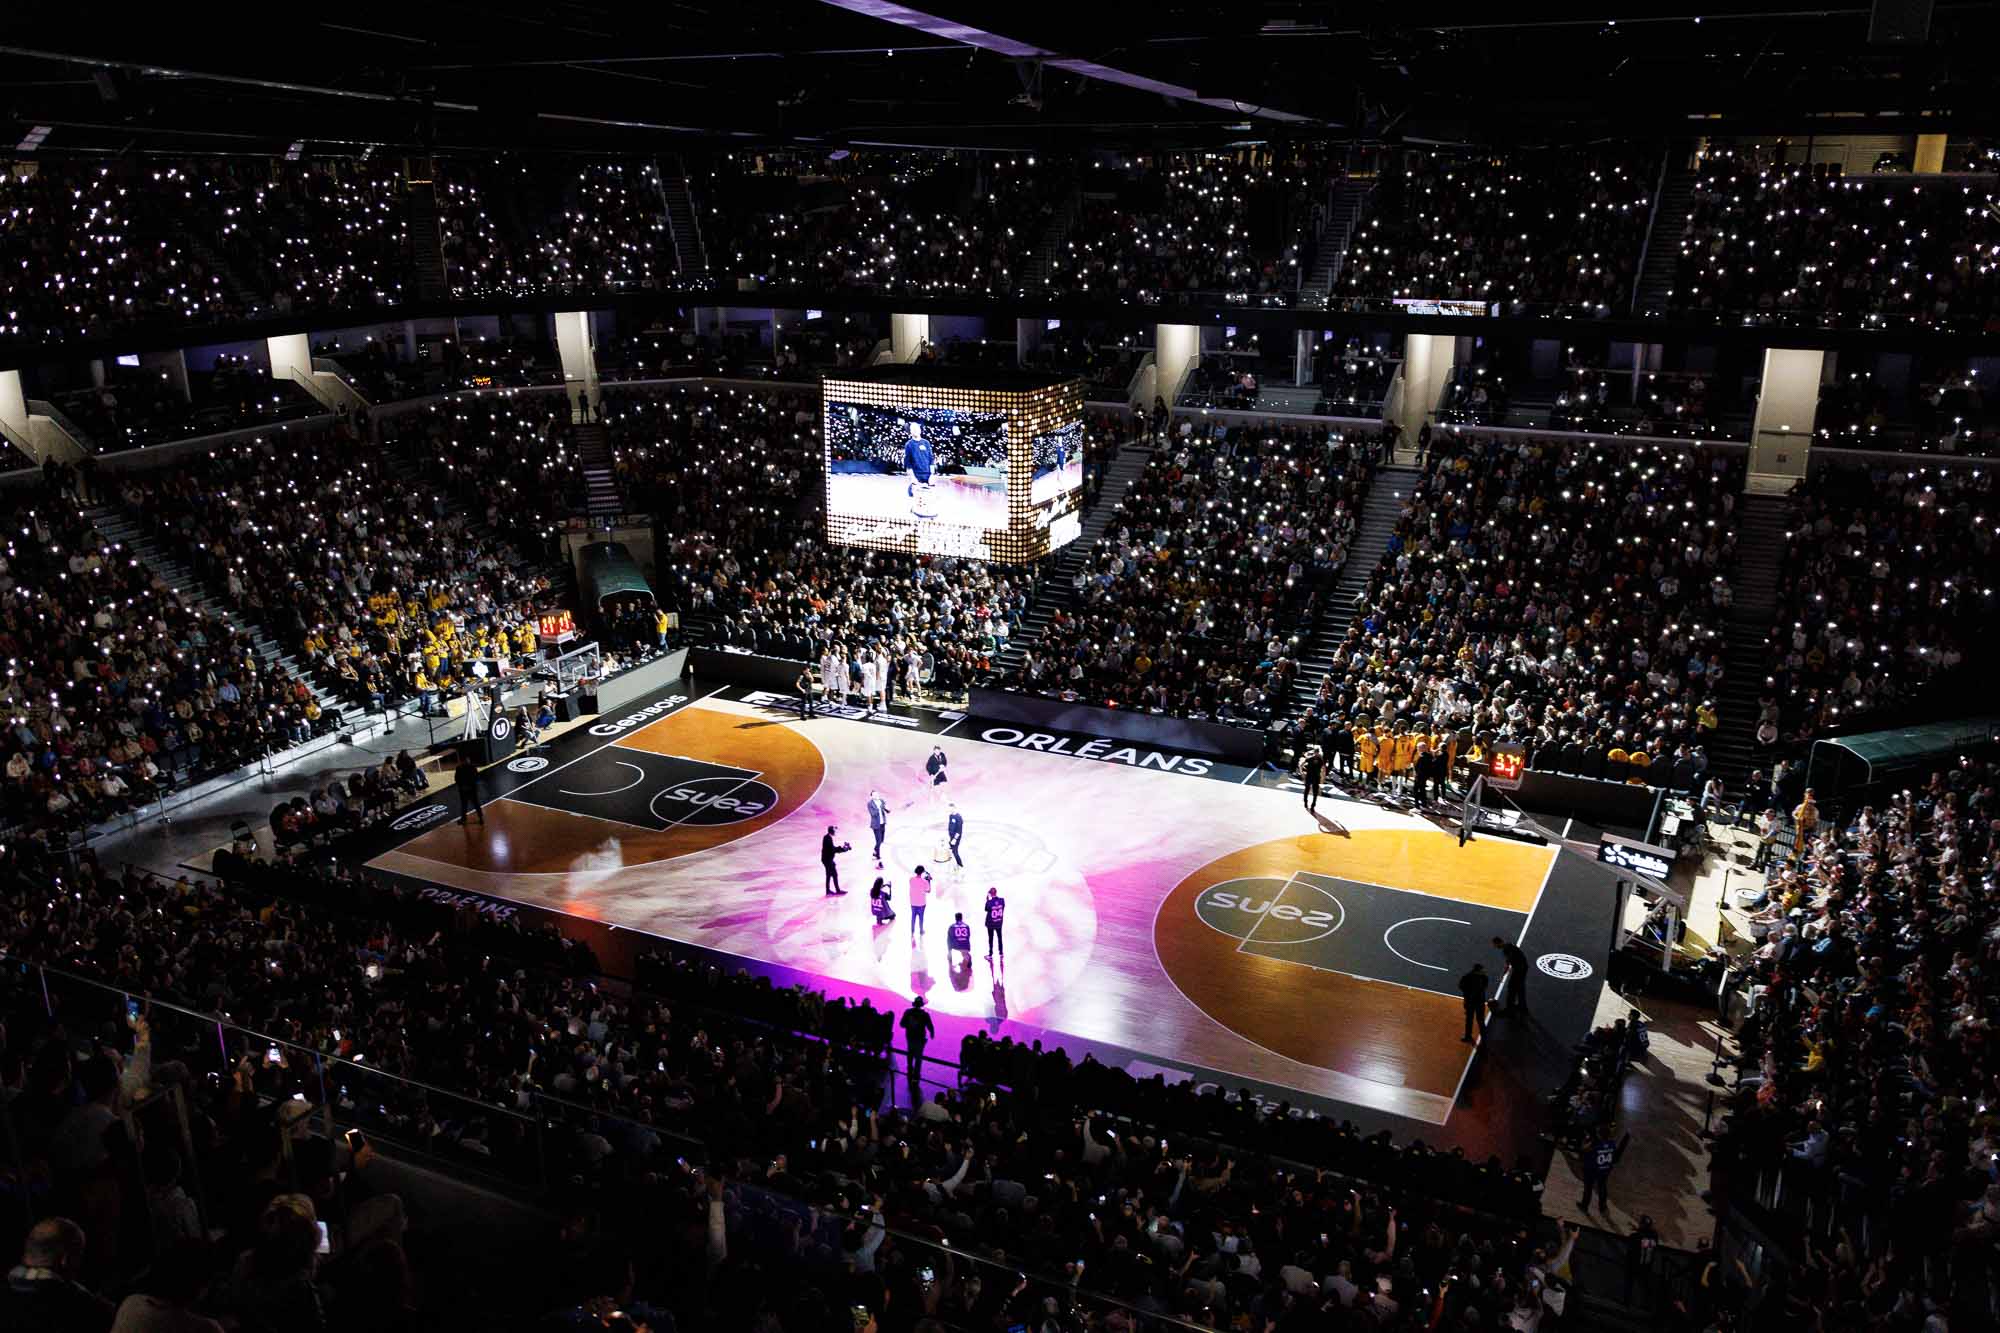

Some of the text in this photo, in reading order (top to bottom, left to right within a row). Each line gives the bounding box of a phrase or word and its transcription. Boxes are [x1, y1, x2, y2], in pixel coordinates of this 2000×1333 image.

[981, 727, 1214, 775] ORLÉANS
[664, 788, 765, 815] suez
[1206, 892, 1334, 928] suez
[954, 927, 968, 937] 03
